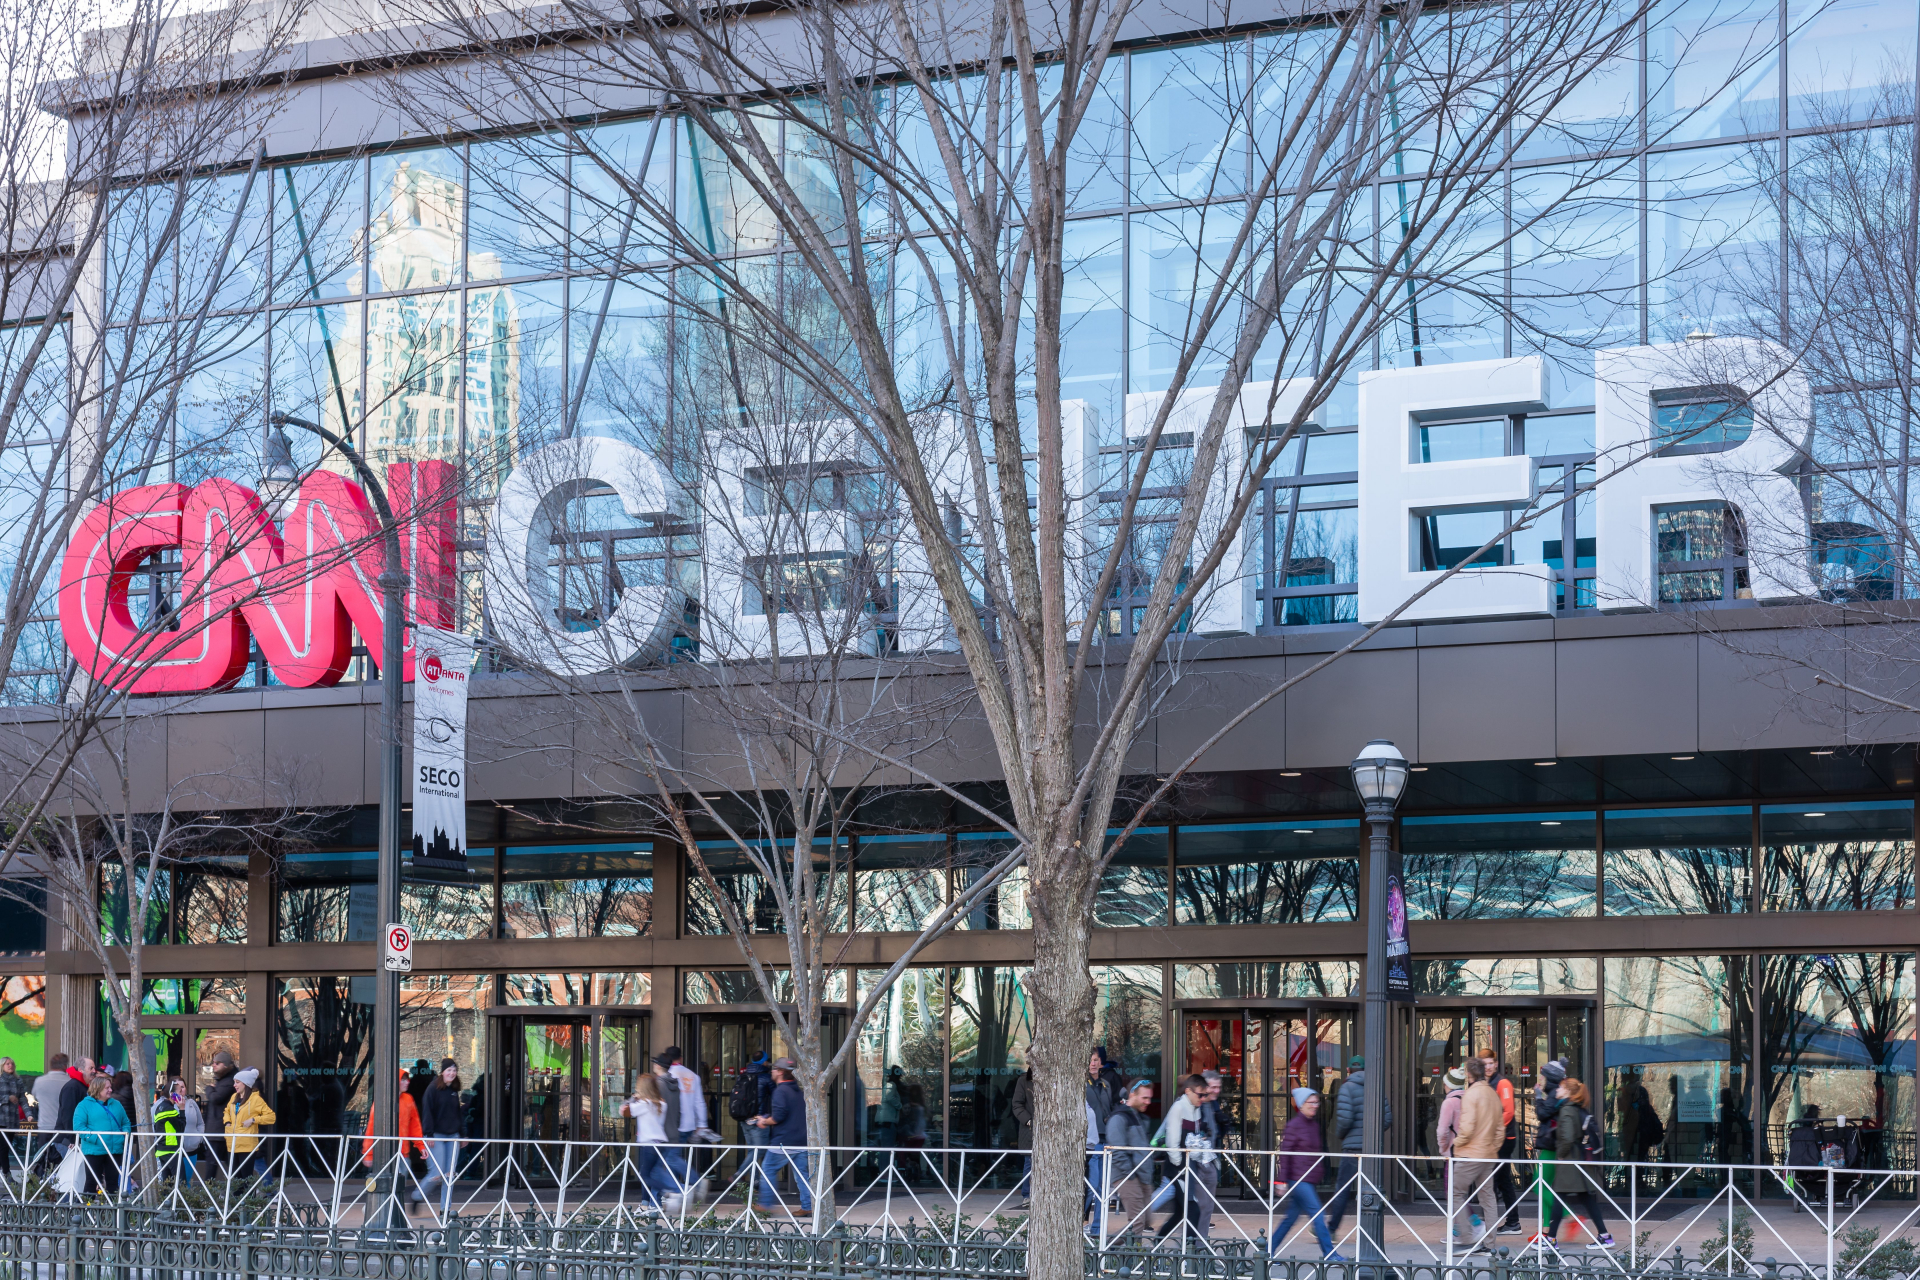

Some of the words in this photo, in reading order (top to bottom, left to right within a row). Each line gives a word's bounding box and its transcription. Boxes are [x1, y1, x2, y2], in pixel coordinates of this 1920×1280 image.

[59, 459, 457, 694] CNN
[482, 337, 1820, 677] CENTER
[427, 664, 465, 682] ATLANTA
[428, 685, 454, 697] welcomes
[419, 766, 460, 788] SECO
[419, 785, 460, 799] International
